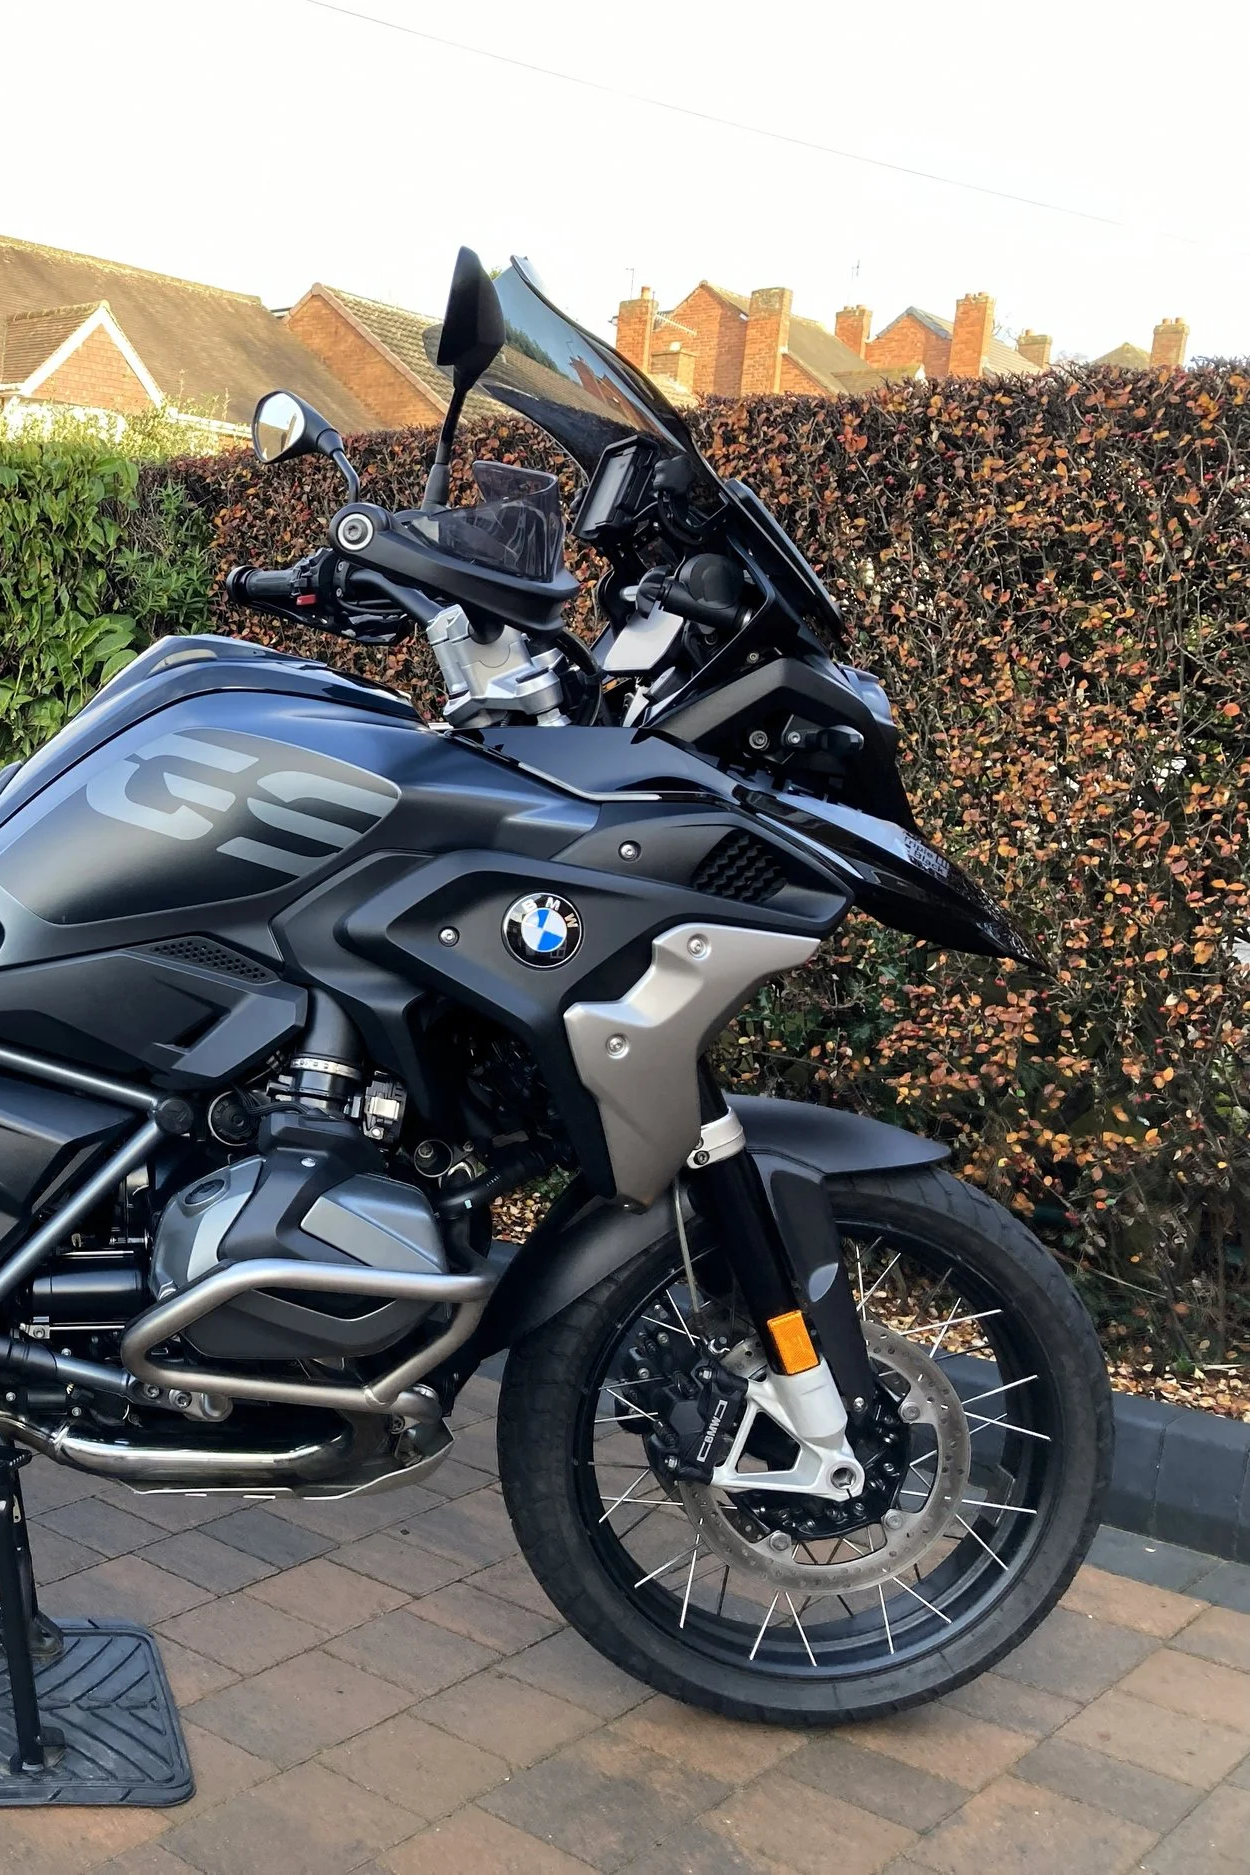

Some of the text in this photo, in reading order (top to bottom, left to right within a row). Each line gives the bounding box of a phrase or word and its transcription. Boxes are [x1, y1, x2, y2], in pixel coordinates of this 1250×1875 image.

[86, 733, 399, 878] GS
[904, 836, 933, 859] Triple
[914, 850, 944, 874] Black
[521, 896, 579, 928] BMW
[704, 1415, 721, 1444] BMW
